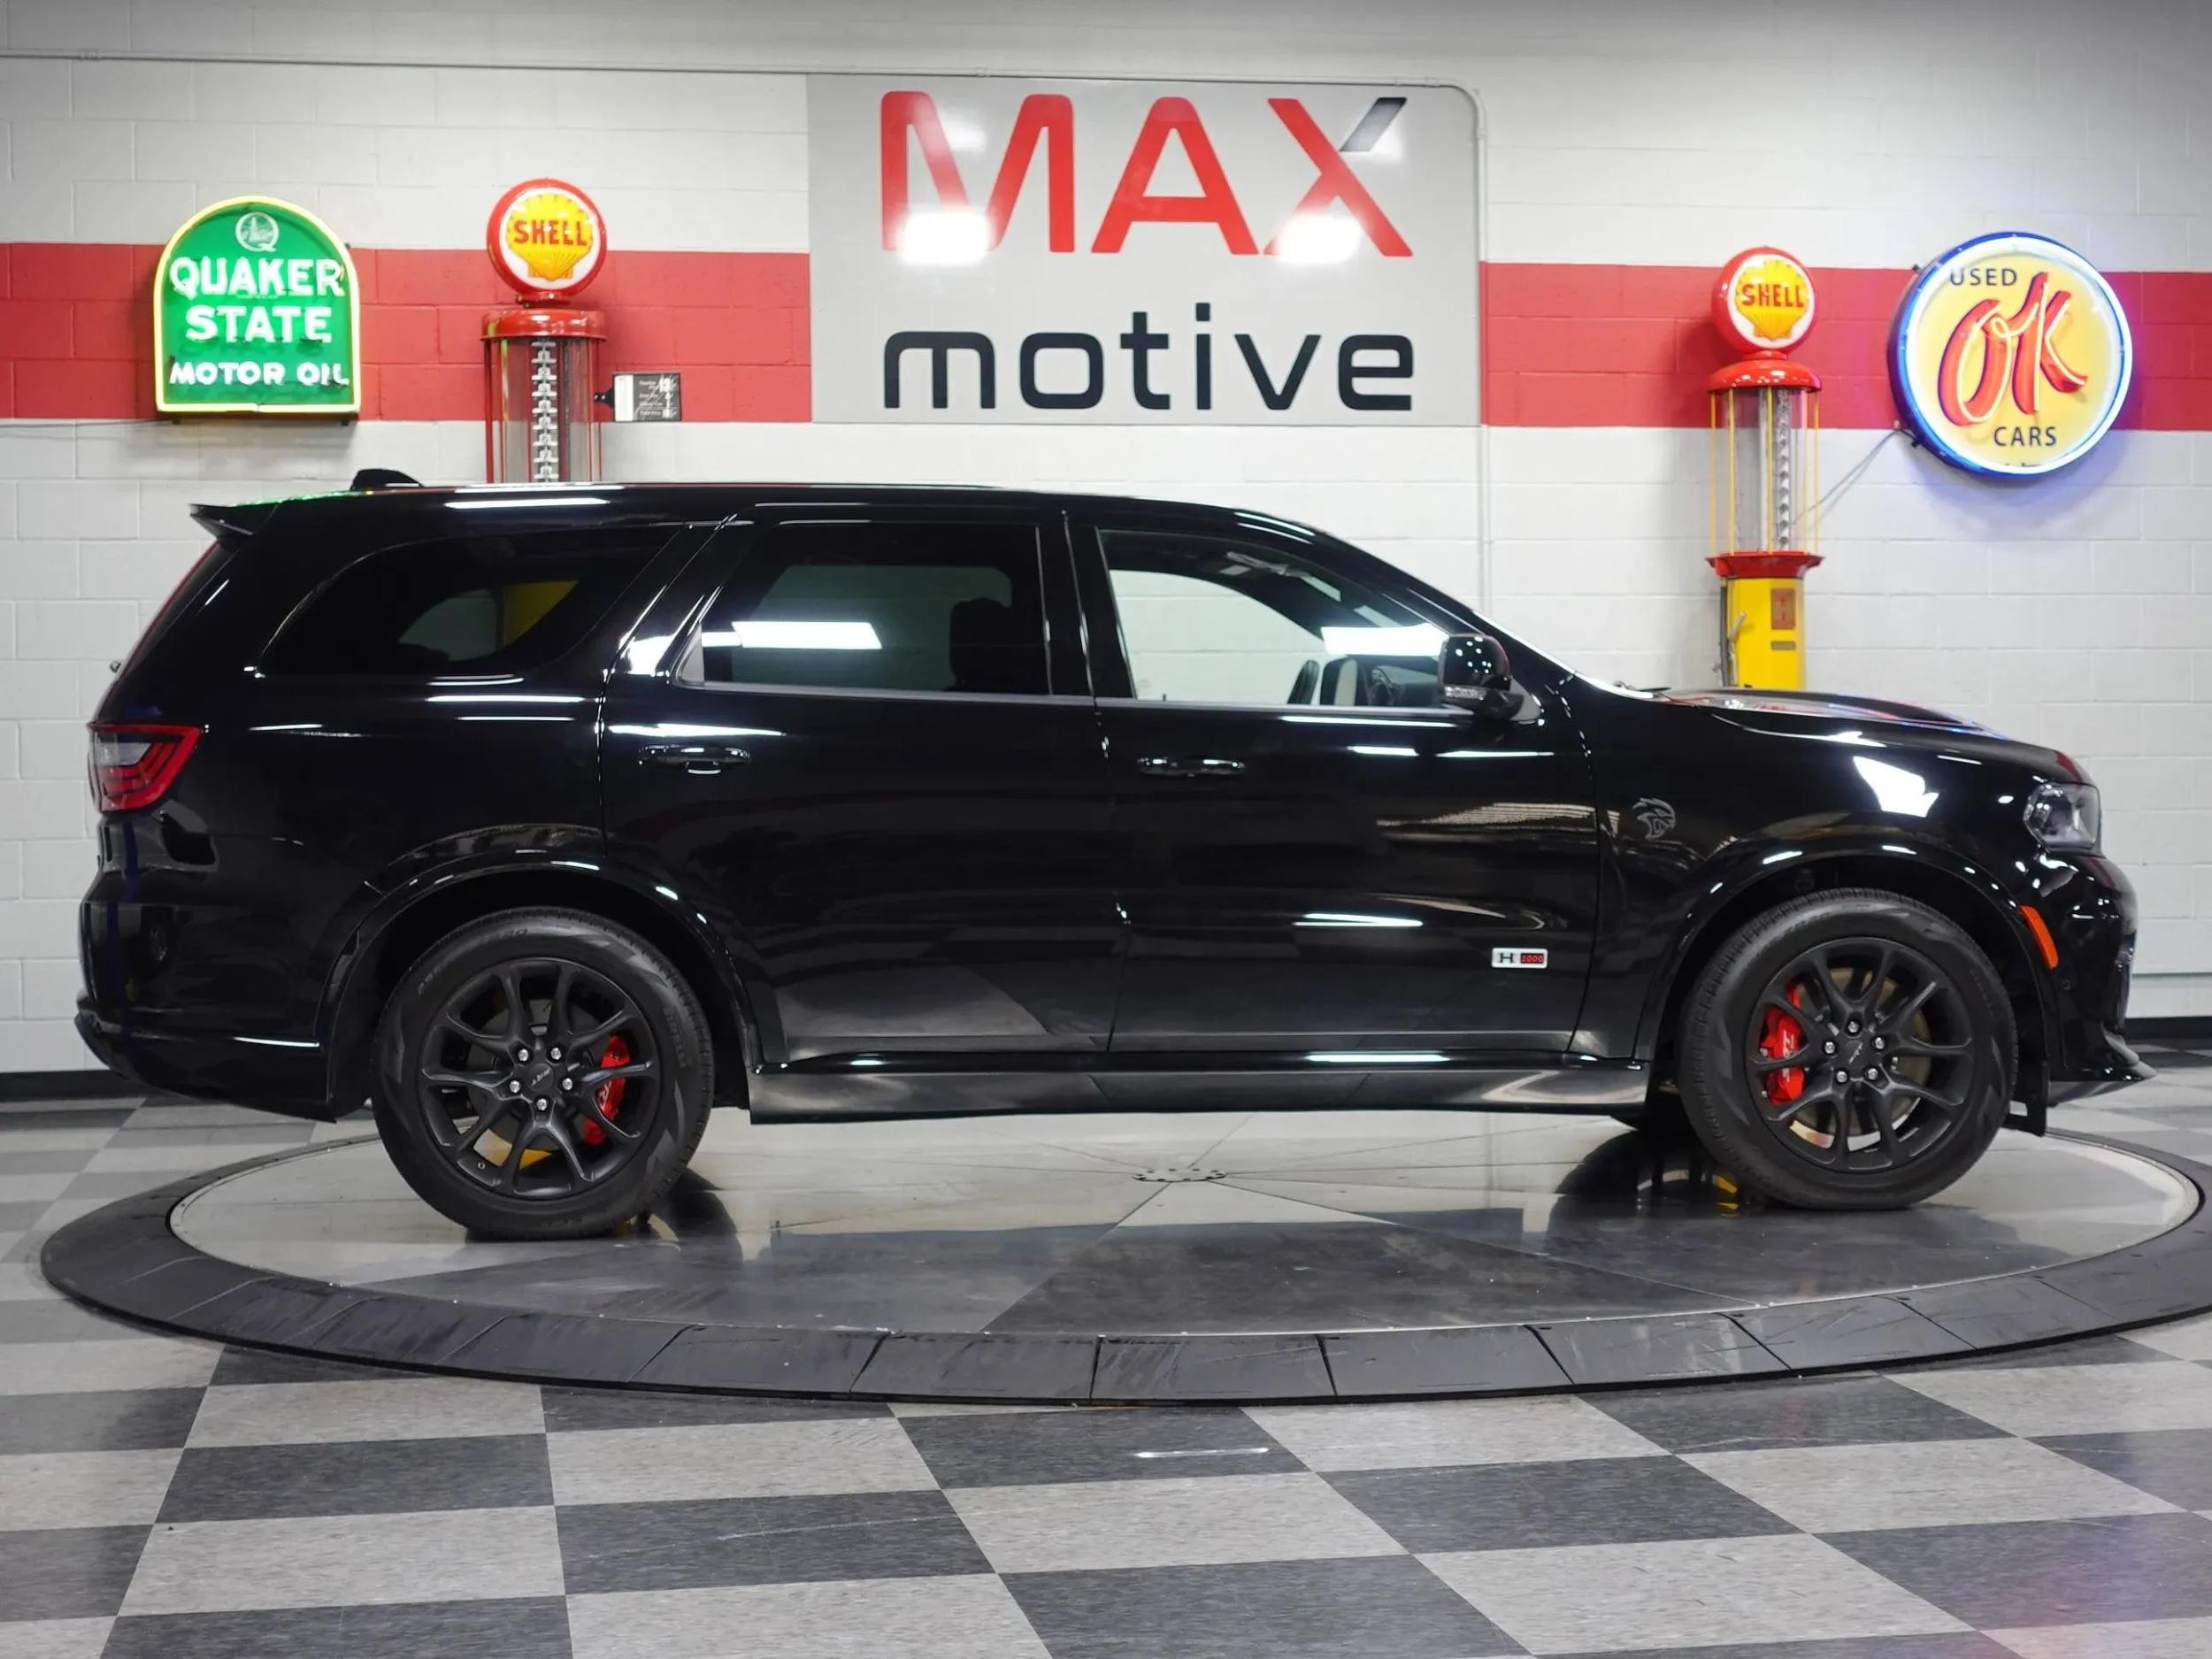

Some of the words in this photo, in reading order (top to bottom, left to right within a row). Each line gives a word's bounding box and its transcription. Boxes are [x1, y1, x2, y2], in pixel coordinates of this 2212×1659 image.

[879, 90, 1413, 257] MAX
[513, 219, 588, 246] SHELL
[170, 256, 344, 300] QUAKER
[1949, 268, 2017, 286] USED
[1741, 283, 1804, 308] SHELL
[185, 304, 333, 343] STATE
[885, 302, 1413, 411] motive
[1938, 272, 2088, 426] OK
[169, 361, 286, 385] MOTOR
[296, 361, 349, 386] OIL
[1993, 426, 2056, 446] CARS
[1499, 953, 1515, 963] H
